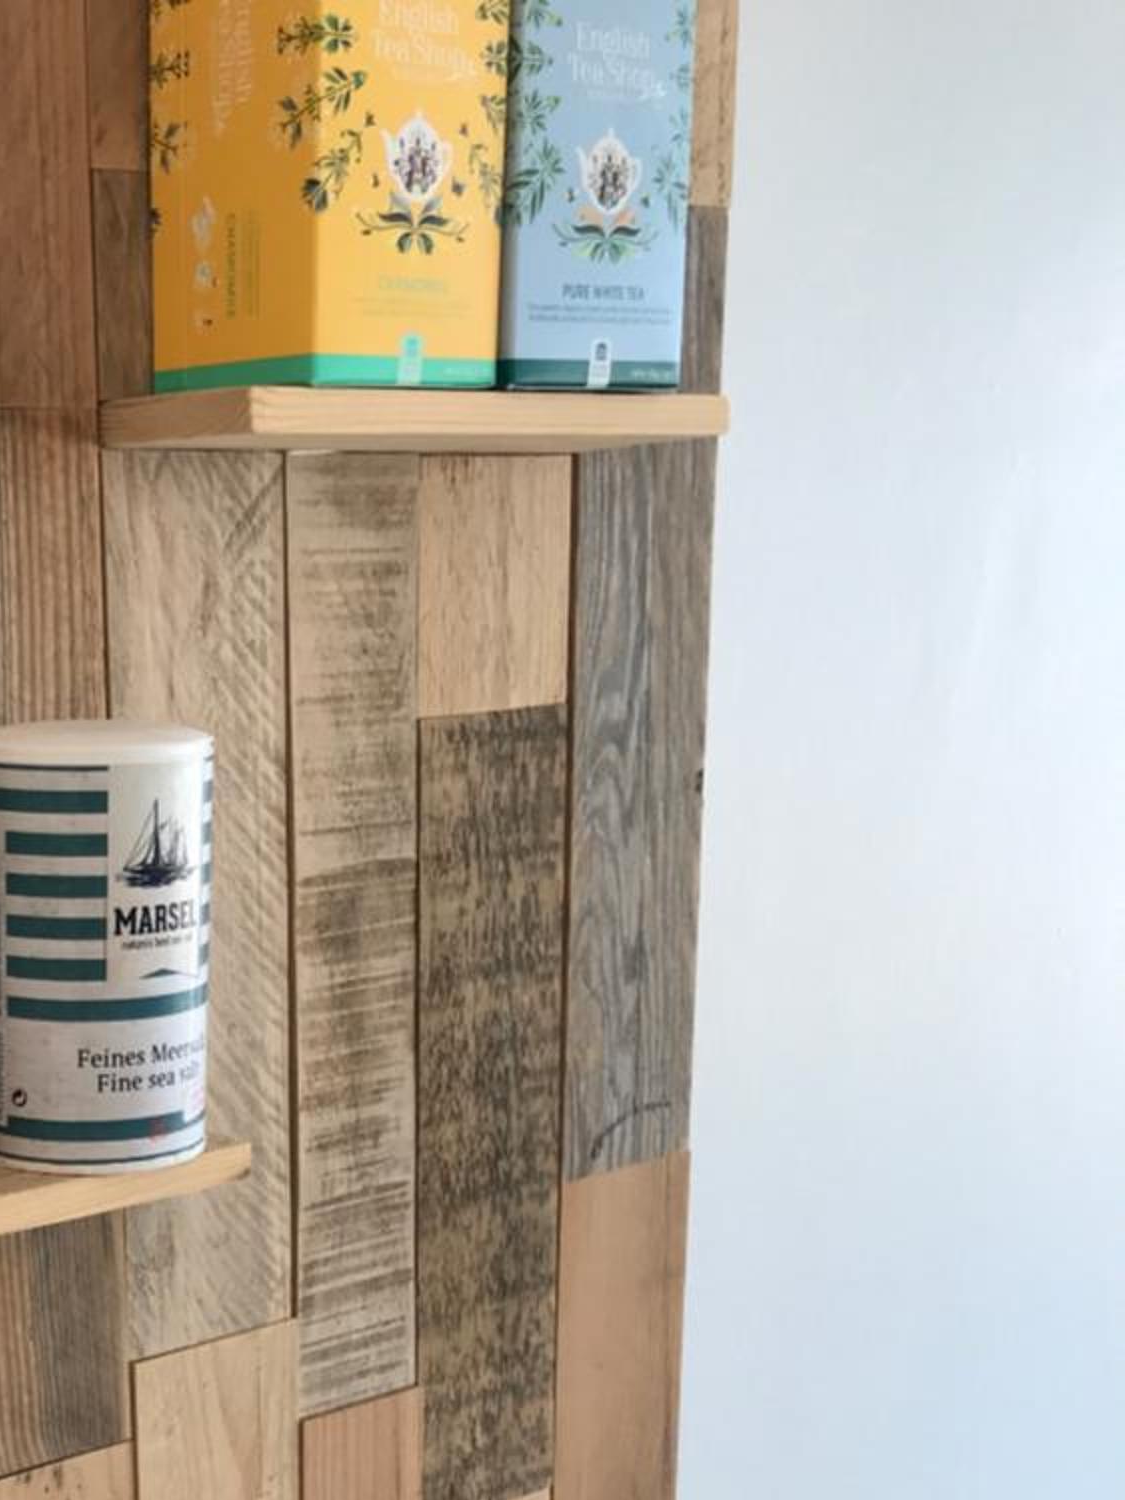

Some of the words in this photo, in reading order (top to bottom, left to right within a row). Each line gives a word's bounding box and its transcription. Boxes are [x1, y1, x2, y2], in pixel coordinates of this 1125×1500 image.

[562, 282, 589, 300] PURE
[593, 285, 623, 300] WHITE
[627, 286, 645, 301] TEA
[77, 1048, 146, 1068] Feines
[97, 1073, 144, 1093] Fine
[148, 1070, 176, 1088] sea
